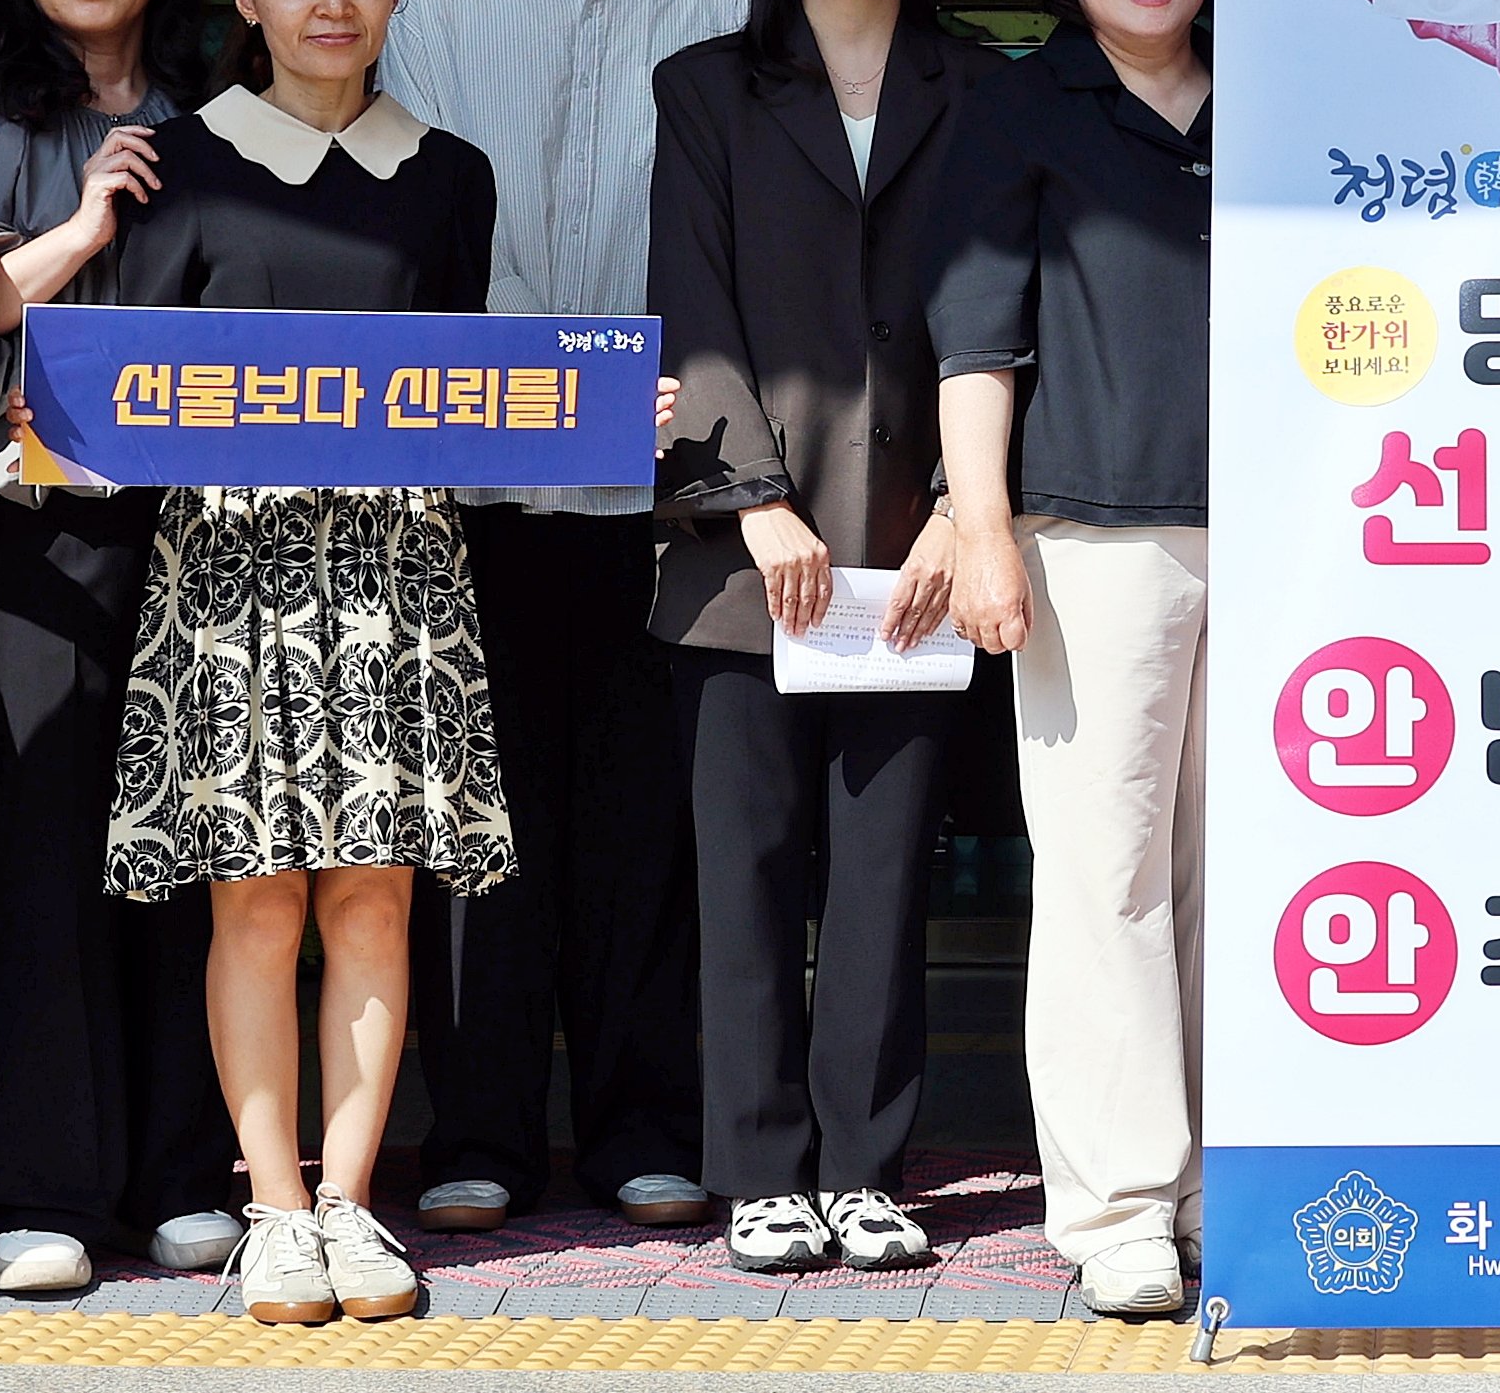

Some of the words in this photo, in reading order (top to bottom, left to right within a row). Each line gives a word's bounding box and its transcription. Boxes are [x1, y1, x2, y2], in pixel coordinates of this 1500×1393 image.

[1327, 147, 1459, 222] 청렴
[1324, 293, 1406, 316] 풍요로운
[612, 329, 645, 353] 화순
[1321, 319, 1410, 351] 한가위
[1322, 355, 1410, 376] 보내세요!
[111, 364, 365, 428] 선물보다
[382, 366, 579, 430] 신뢰를!
[1300, 665, 1428, 788] 안
[1300, 891, 1430, 1016] 안
[1333, 1225, 1378, 1253] 의회
